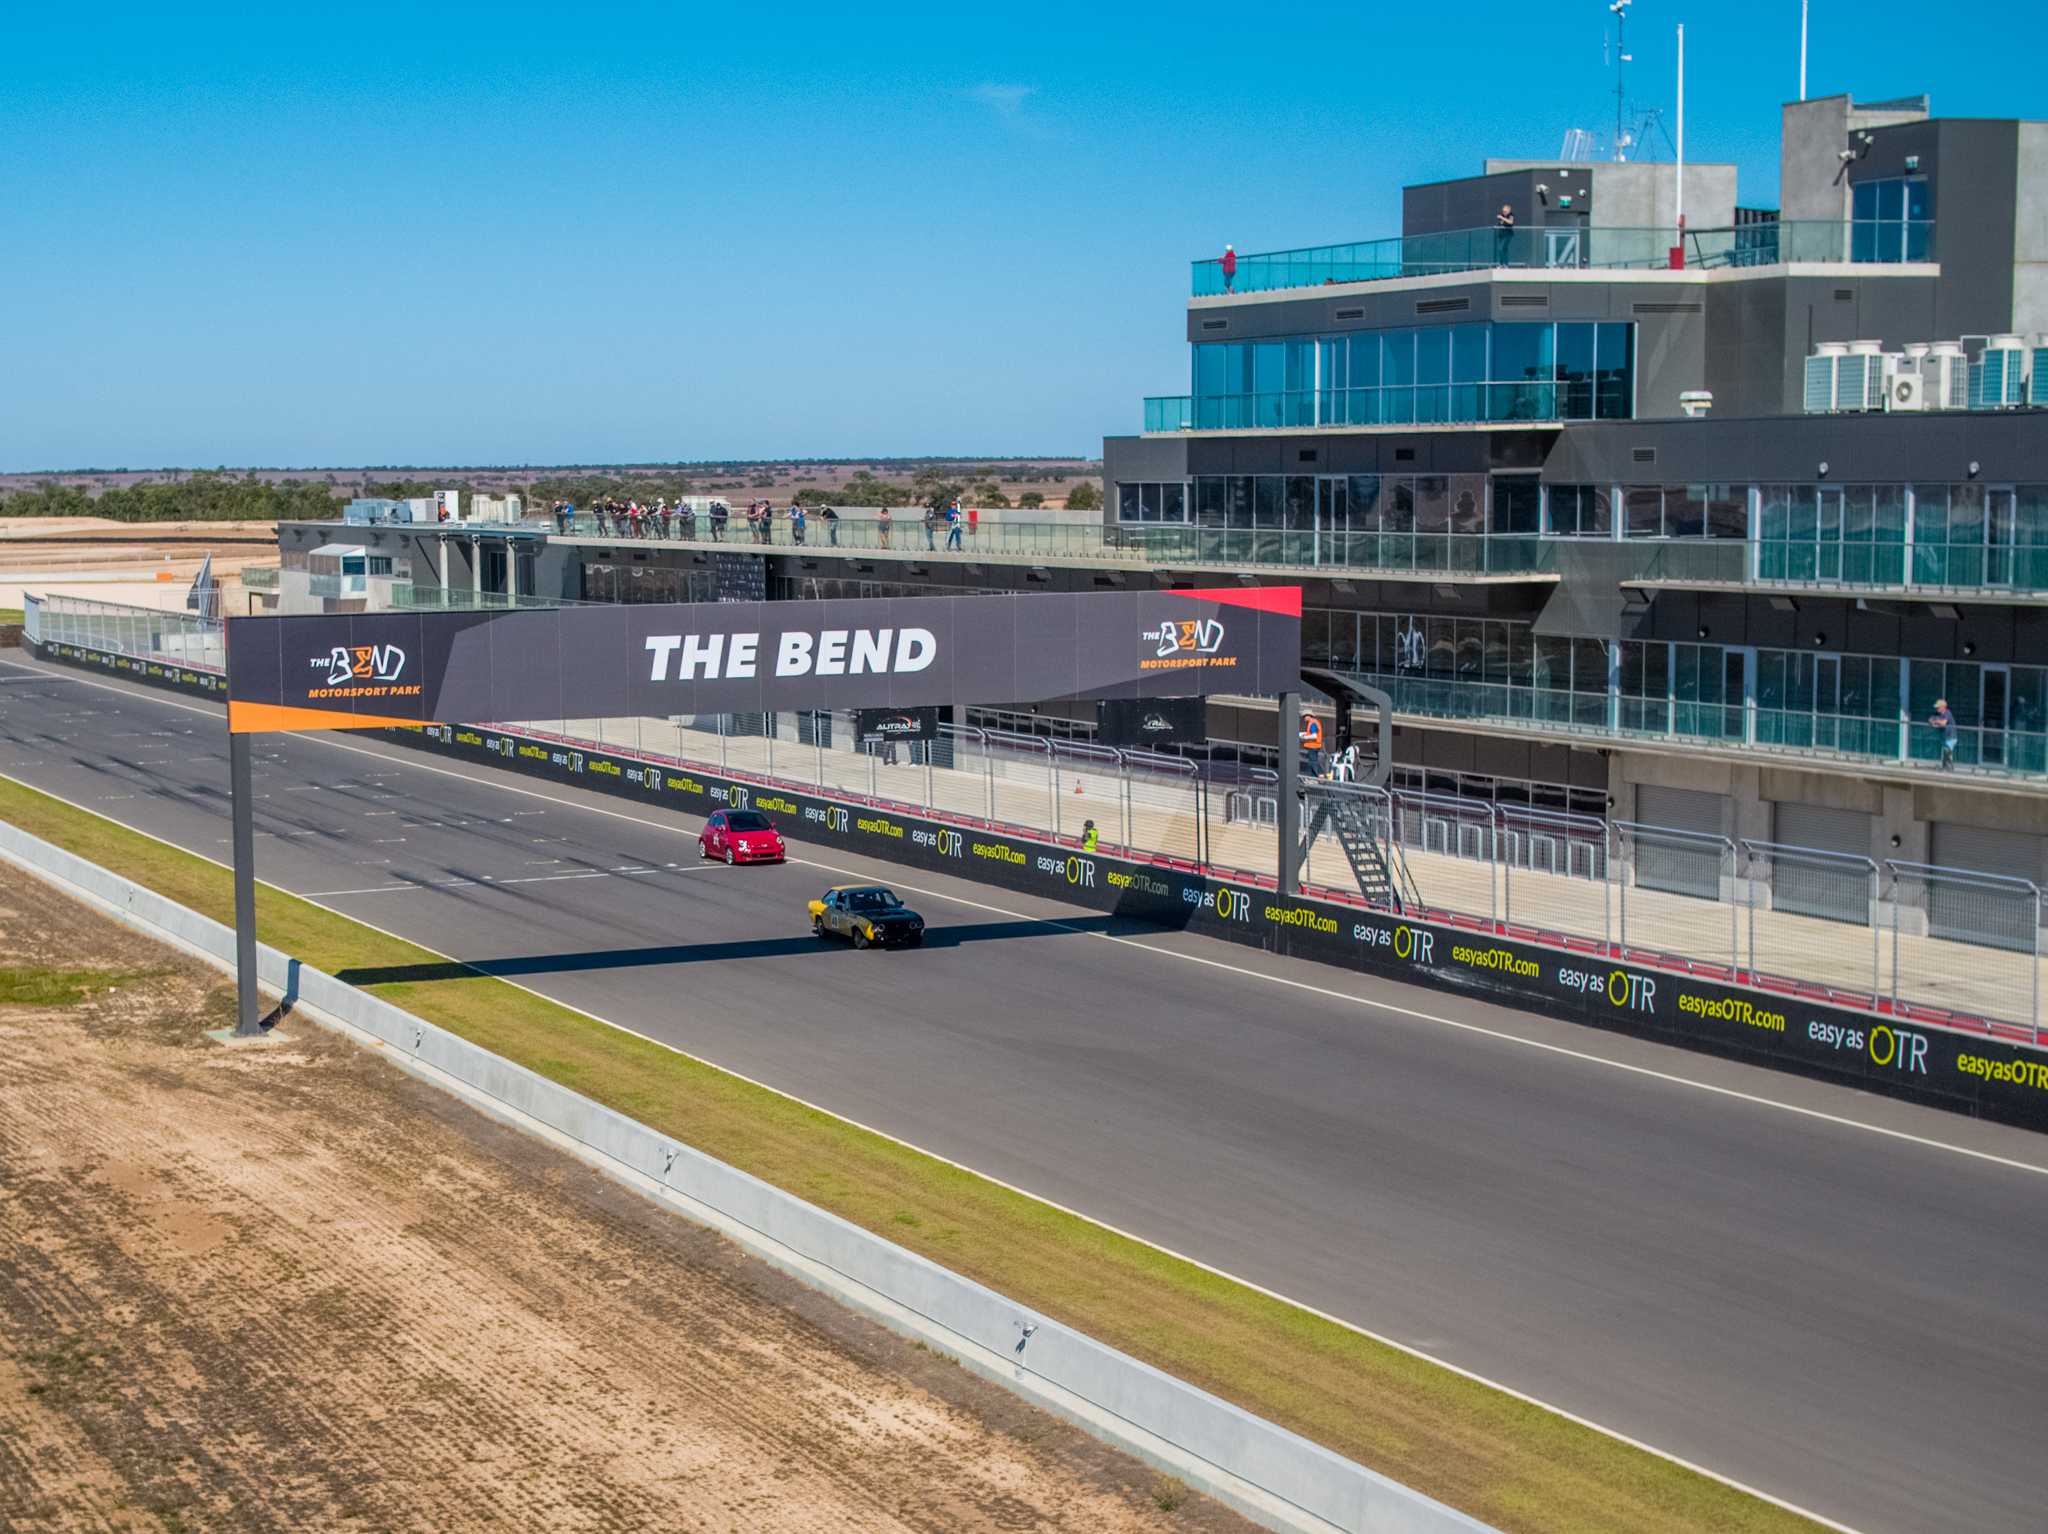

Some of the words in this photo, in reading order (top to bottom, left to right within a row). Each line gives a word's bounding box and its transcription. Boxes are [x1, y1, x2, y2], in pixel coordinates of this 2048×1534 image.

[1143, 632, 1160, 640] THE
[1156, 619, 1224, 657] BEND
[310, 658, 331, 668] THE
[327, 644, 405, 685] BEND
[645, 633, 759, 681] THE
[775, 628, 936, 677] BEND
[1141, 658, 1207, 669] MOTORSPORT
[1210, 657, 1237, 667] PARK
[308, 686, 387, 699] MOTORSPORT
[390, 685, 421, 696] PARK
[568, 752, 583, 773] OTR
[627, 768, 638, 782] easy
[637, 772, 643, 782] as
[644, 767, 661, 791] OTR
[710, 786, 722, 802] easy
[722, 790, 729, 801] as
[729, 785, 749, 810] OTR
[756, 797, 797, 815] easyasOTR.com
[804, 807, 818, 824] easy
[818, 811, 826, 822] as
[826, 806, 848, 833] OTR
[857, 817, 903, 838] easyasOTR.com
[912, 829, 928, 847] easy
[928, 833, 936, 845] as
[938, 829, 962, 858] OTR
[973, 842, 1026, 865] easyasOTR.com
[1037, 855, 1055, 875] easy
[1055, 860, 1064, 874] as
[1066, 856, 1095, 888] OTR
[1107, 870, 1169, 897] easyasOTR.com
[1182, 886, 1204, 908] easy
[1204, 893, 1214, 907] as
[1217, 888, 1250, 922] OTR
[1265, 905, 1338, 933] easyasOTR.com
[1353, 923, 1378, 946] easy
[1378, 931, 1391, 945] as
[1394, 926, 1434, 964] OTR
[1453, 944, 1539, 977] easyasOTR.com
[1559, 965, 1589, 991] easy
[1590, 976, 1604, 993] as
[1609, 970, 1656, 1014] OTR
[1679, 994, 1785, 1032] easyasOTR.com
[1808, 1020, 1845, 1050] easy
[1846, 1030, 1864, 1049] as
[1870, 1026, 1928, 1075] OTR
[1957, 1053, 2048, 1090] easyasOTR
